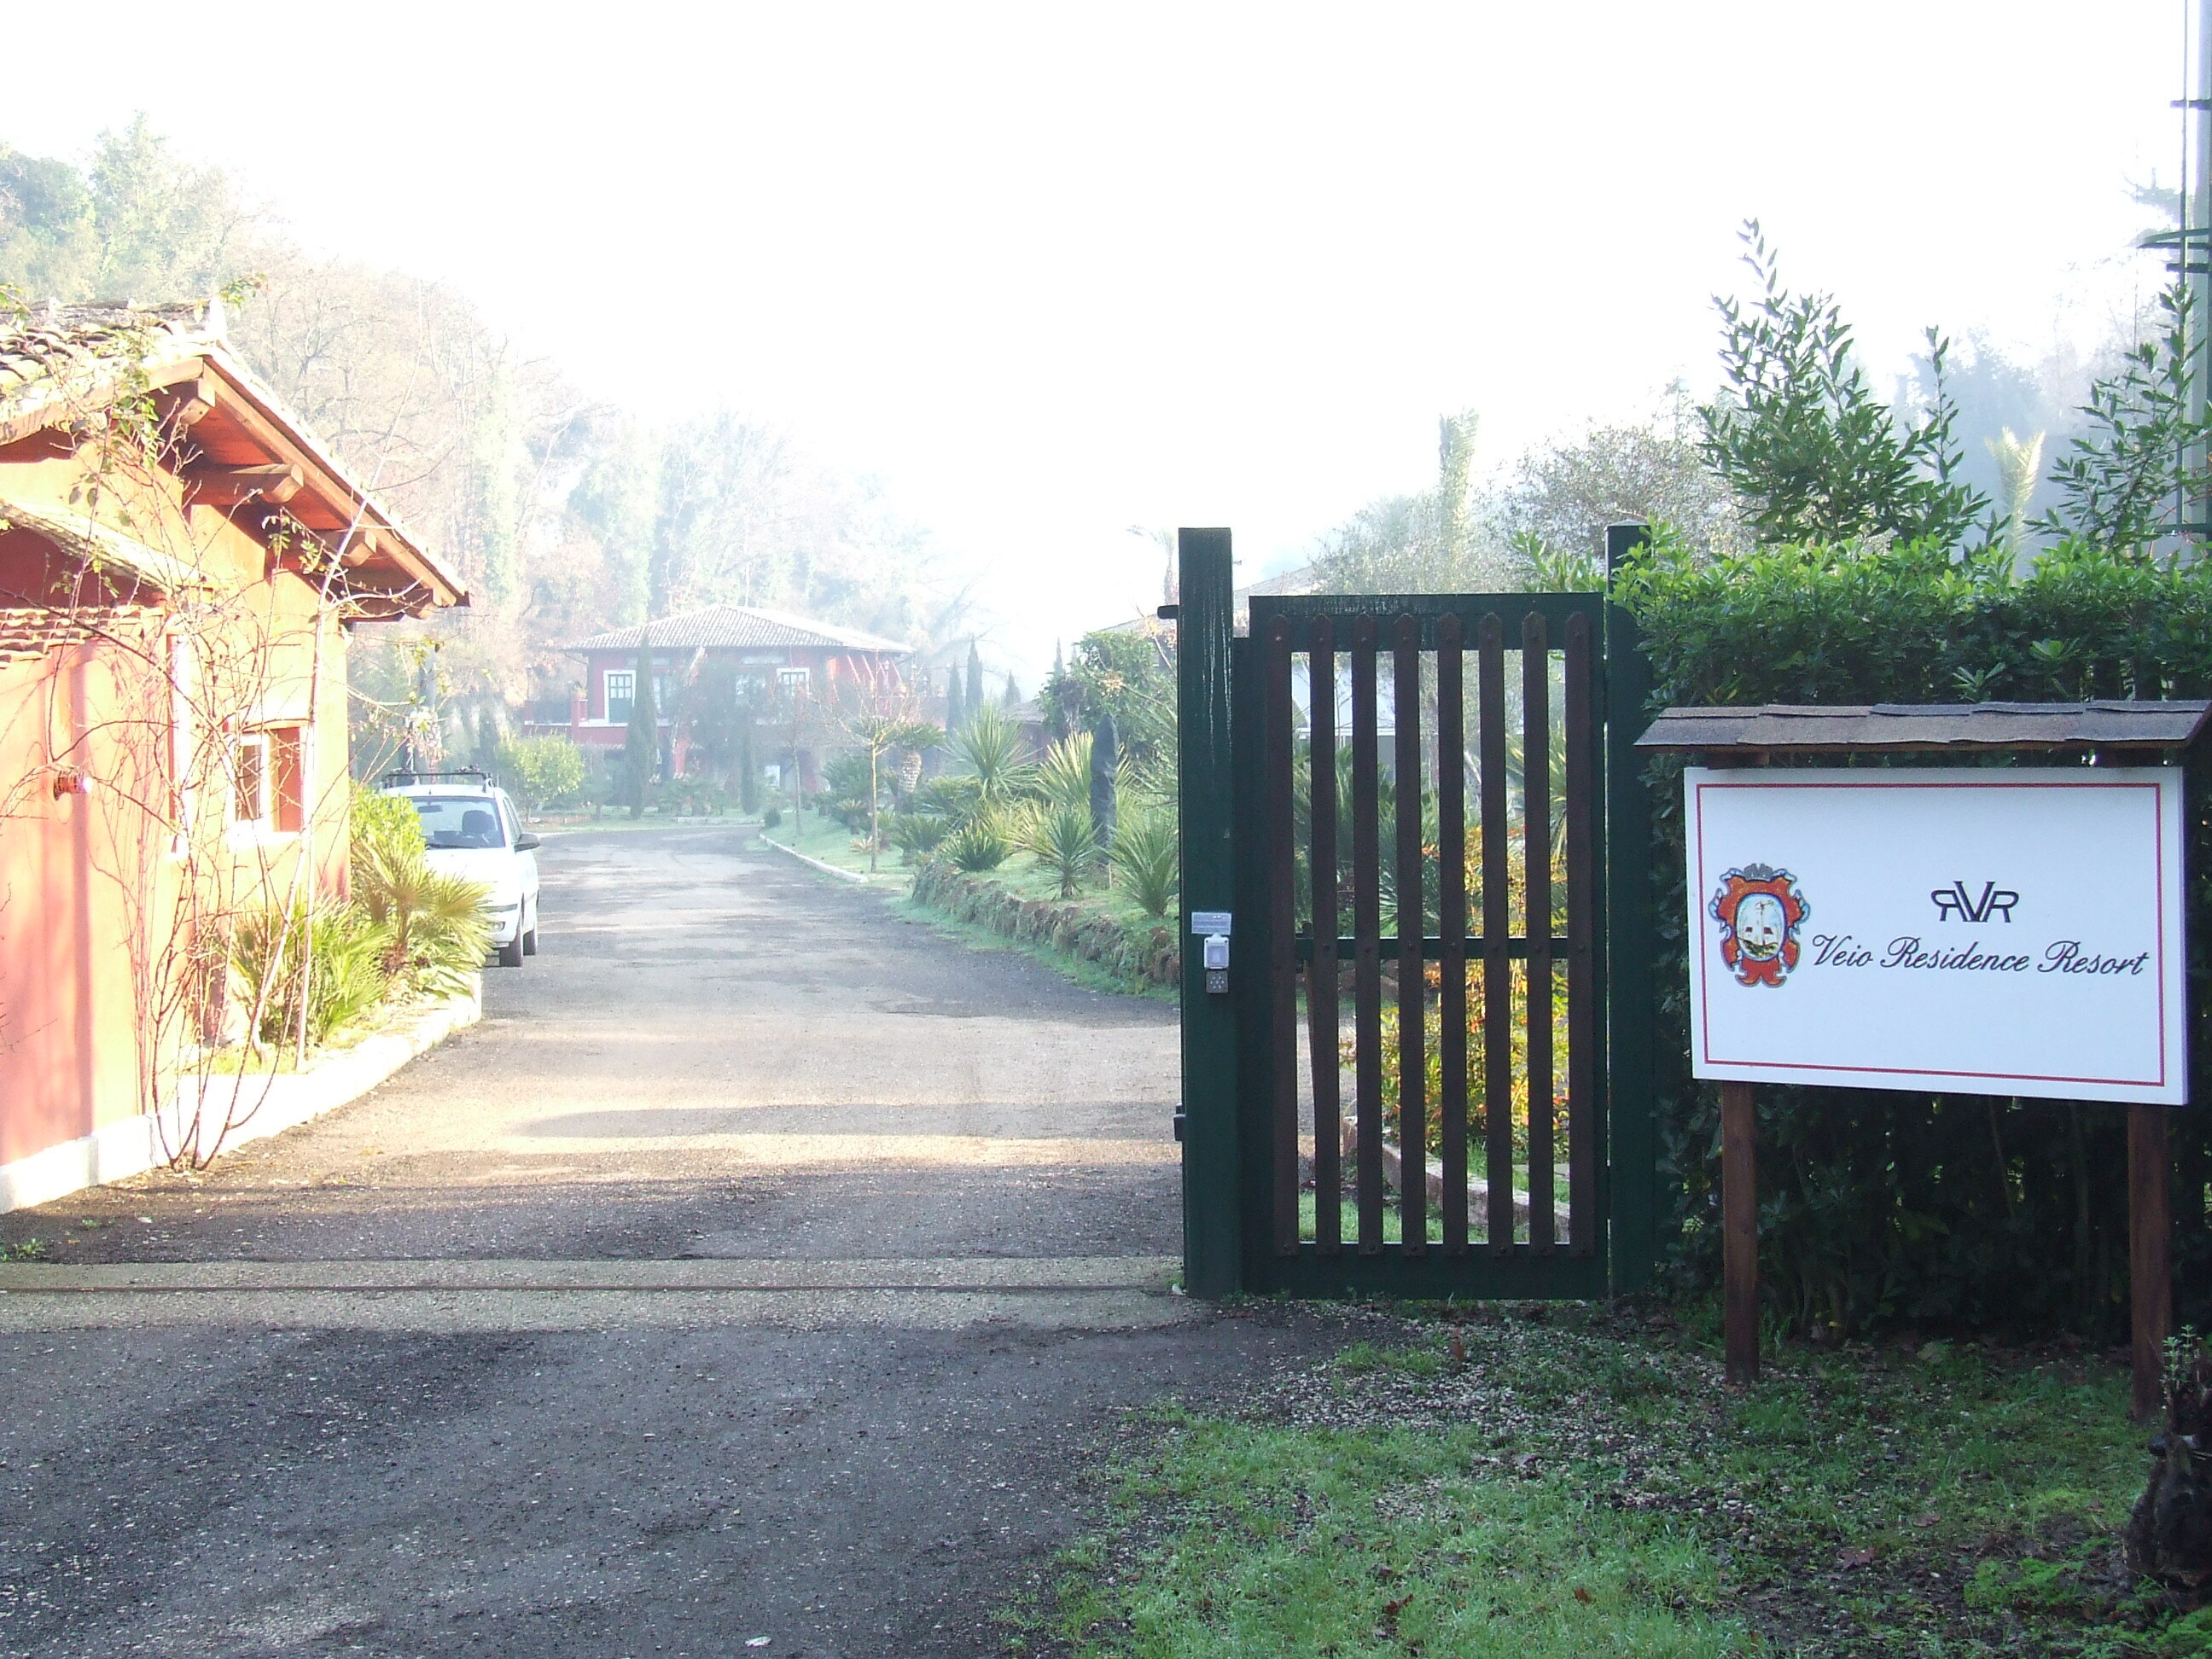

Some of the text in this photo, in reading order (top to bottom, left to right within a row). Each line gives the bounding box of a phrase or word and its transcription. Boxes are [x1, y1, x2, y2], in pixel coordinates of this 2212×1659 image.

[1812, 934, 2150, 975] Veio Residence Resort
